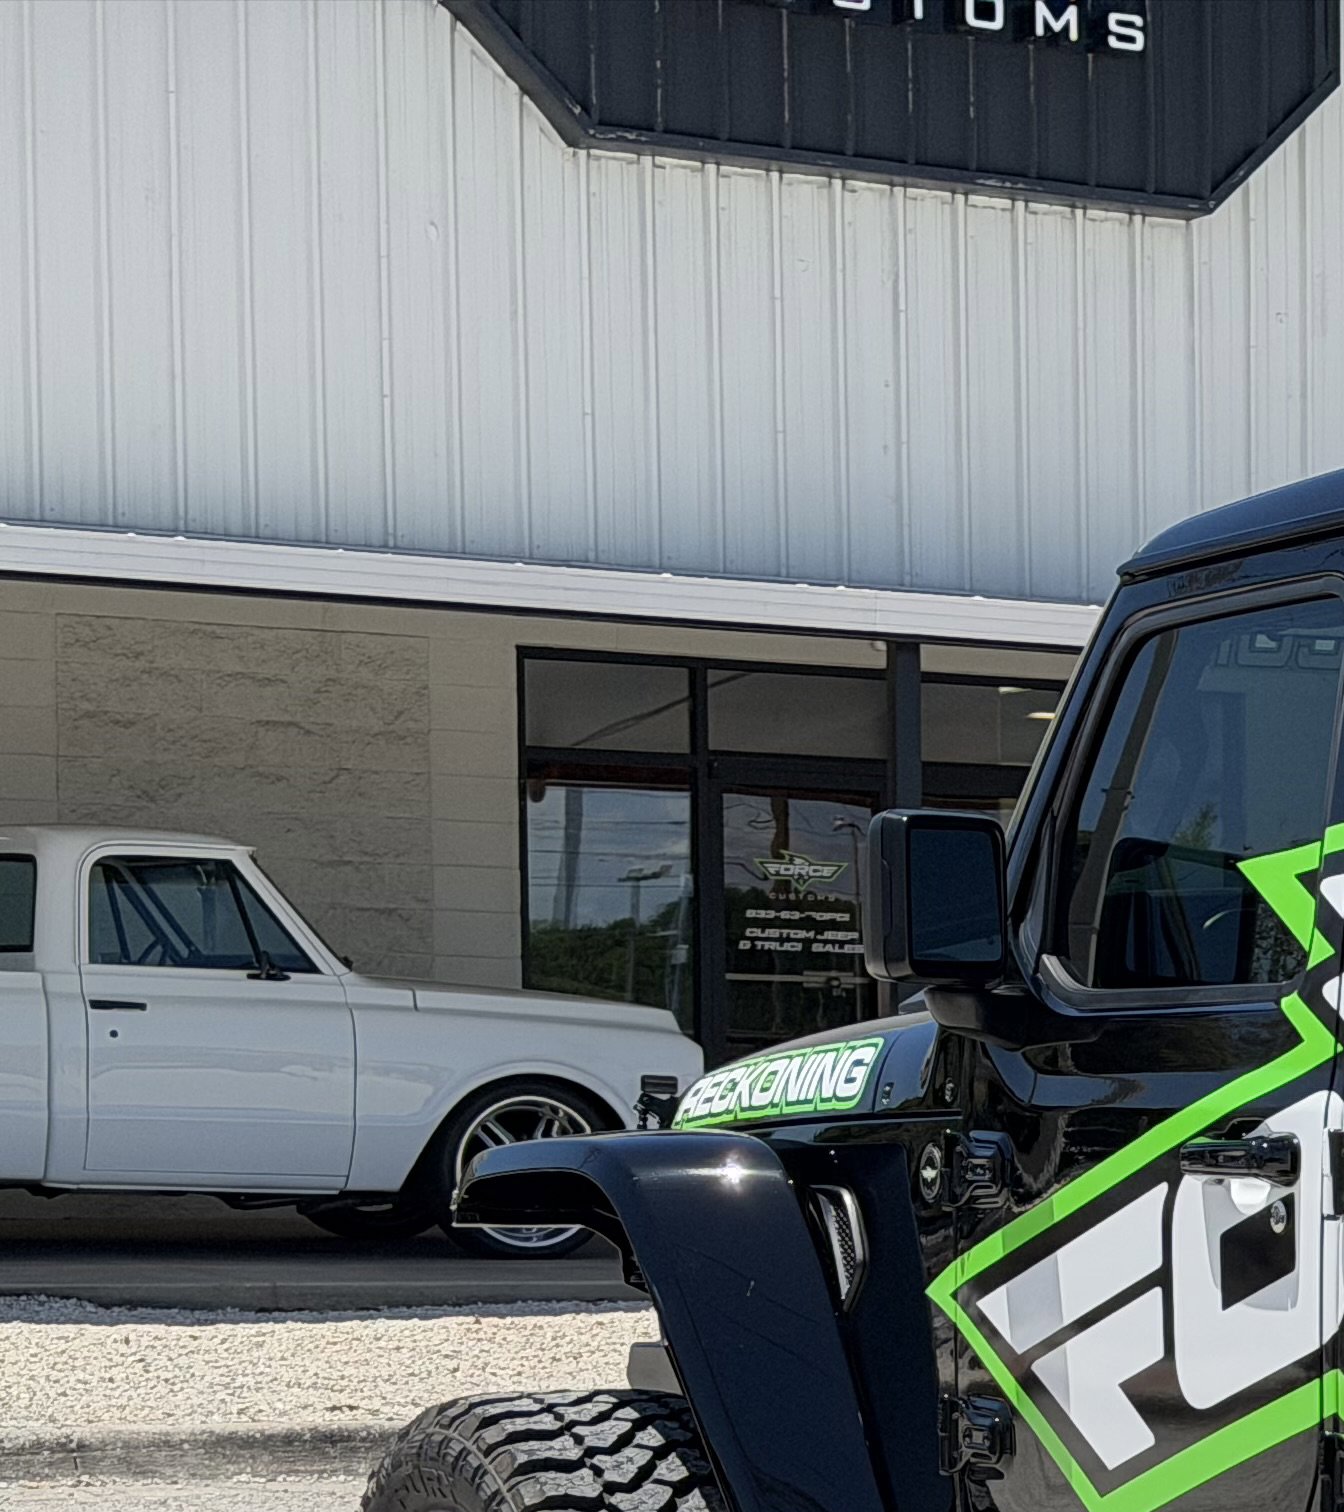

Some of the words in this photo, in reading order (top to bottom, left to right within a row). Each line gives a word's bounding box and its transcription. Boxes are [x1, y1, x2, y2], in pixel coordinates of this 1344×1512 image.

[832, 0, 1146, 52] OMS
[762, 863, 839, 877] FORCE
[745, 927, 815, 940] CUSTOM
[675, 1046, 877, 1127] RECKONING
